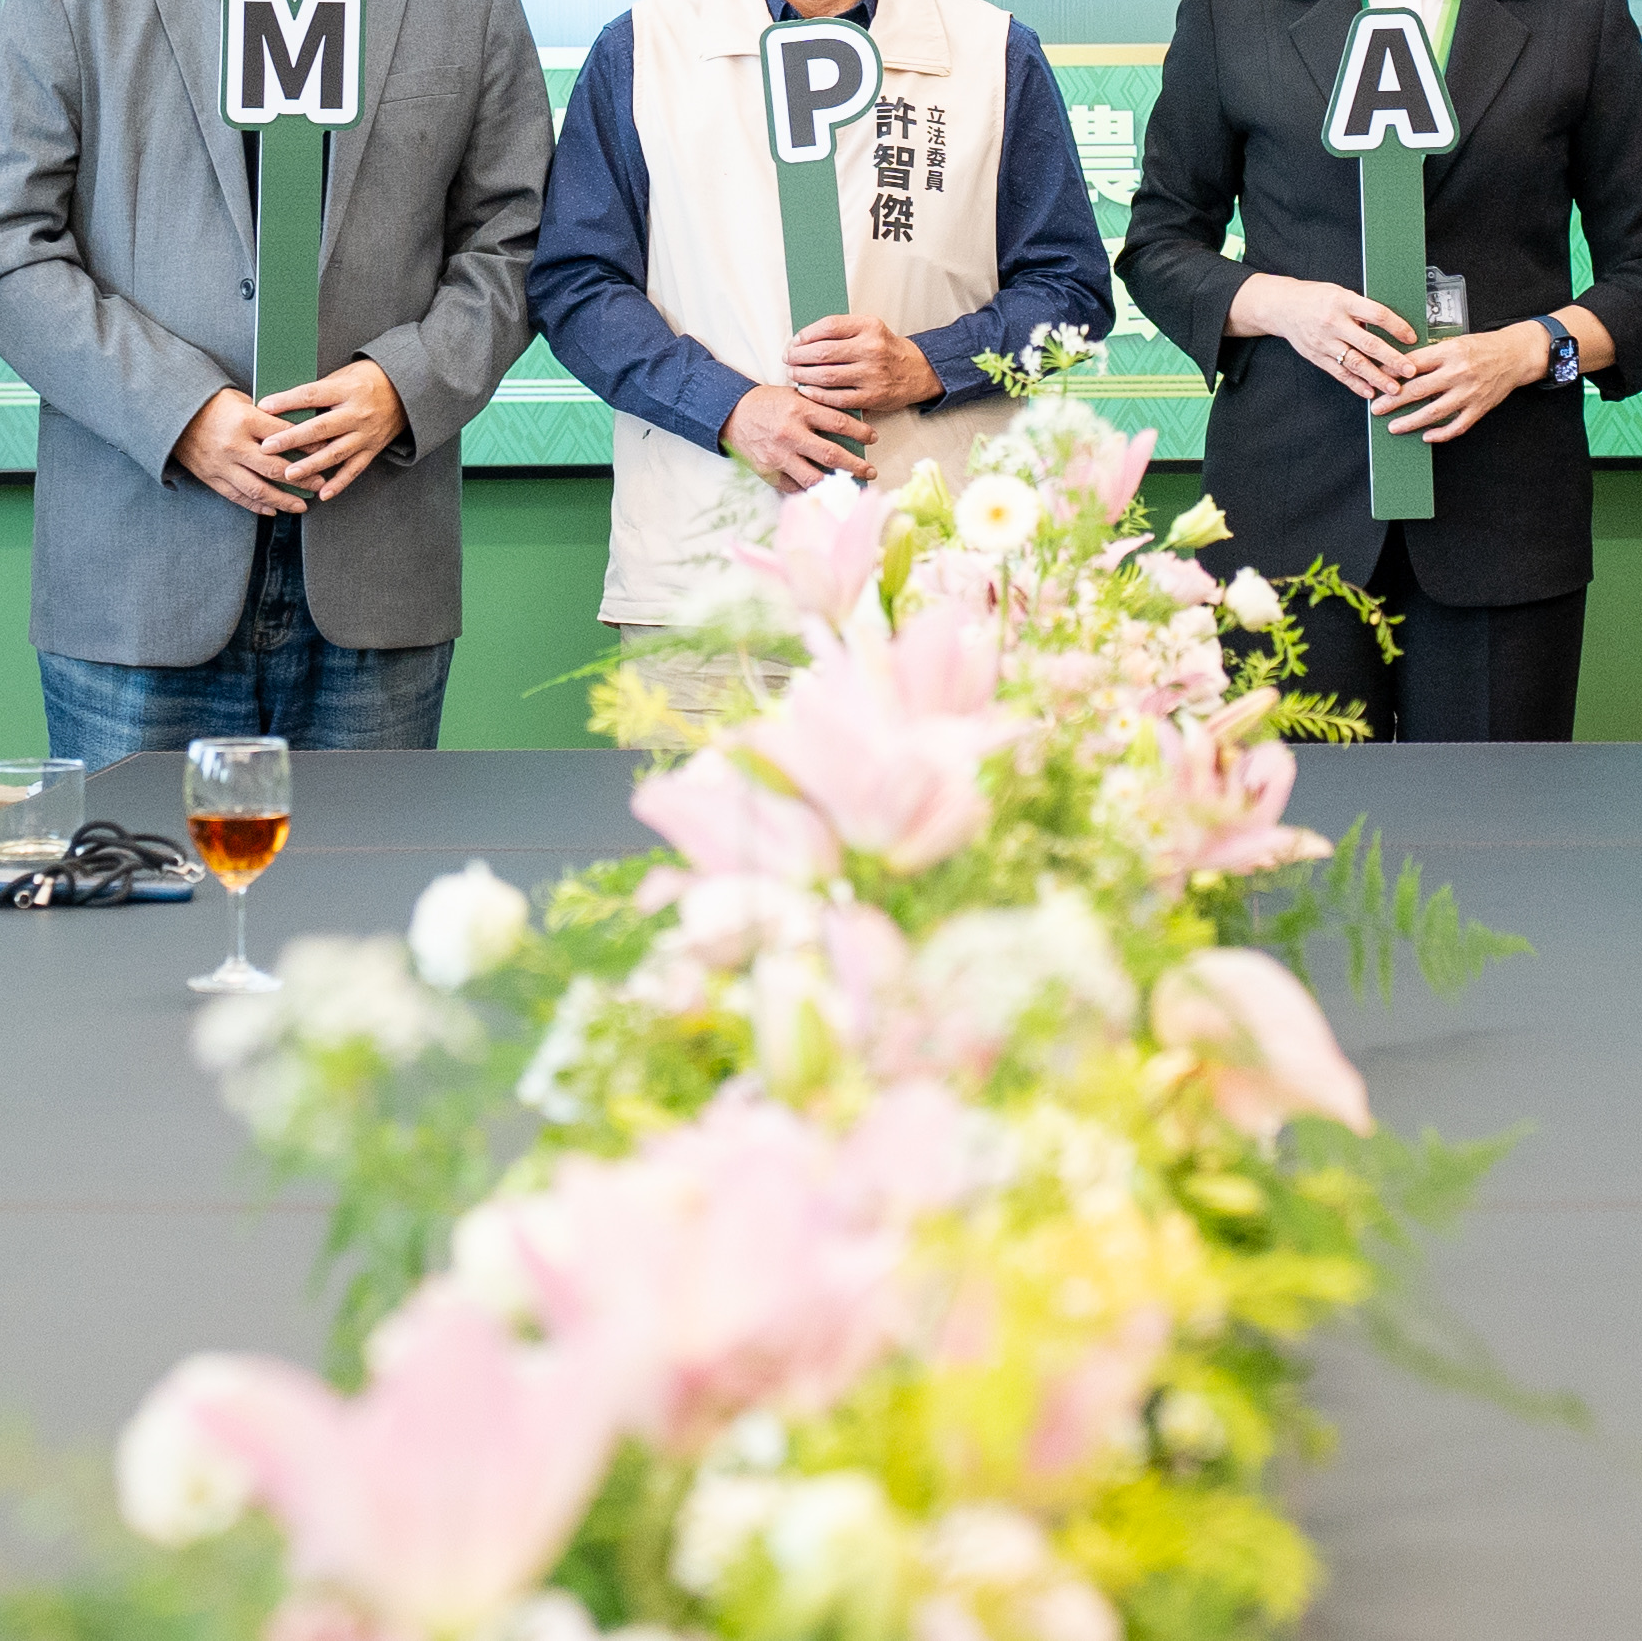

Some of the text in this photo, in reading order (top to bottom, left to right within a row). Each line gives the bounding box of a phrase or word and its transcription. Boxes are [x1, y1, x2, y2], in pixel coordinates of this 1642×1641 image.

[241, 1, 346, 109] M
[781, 38, 863, 148] P
[1343, 28, 1439, 136] A
[869, 95, 917, 242] 許智傑
[924, 105, 946, 192] 立法委員
